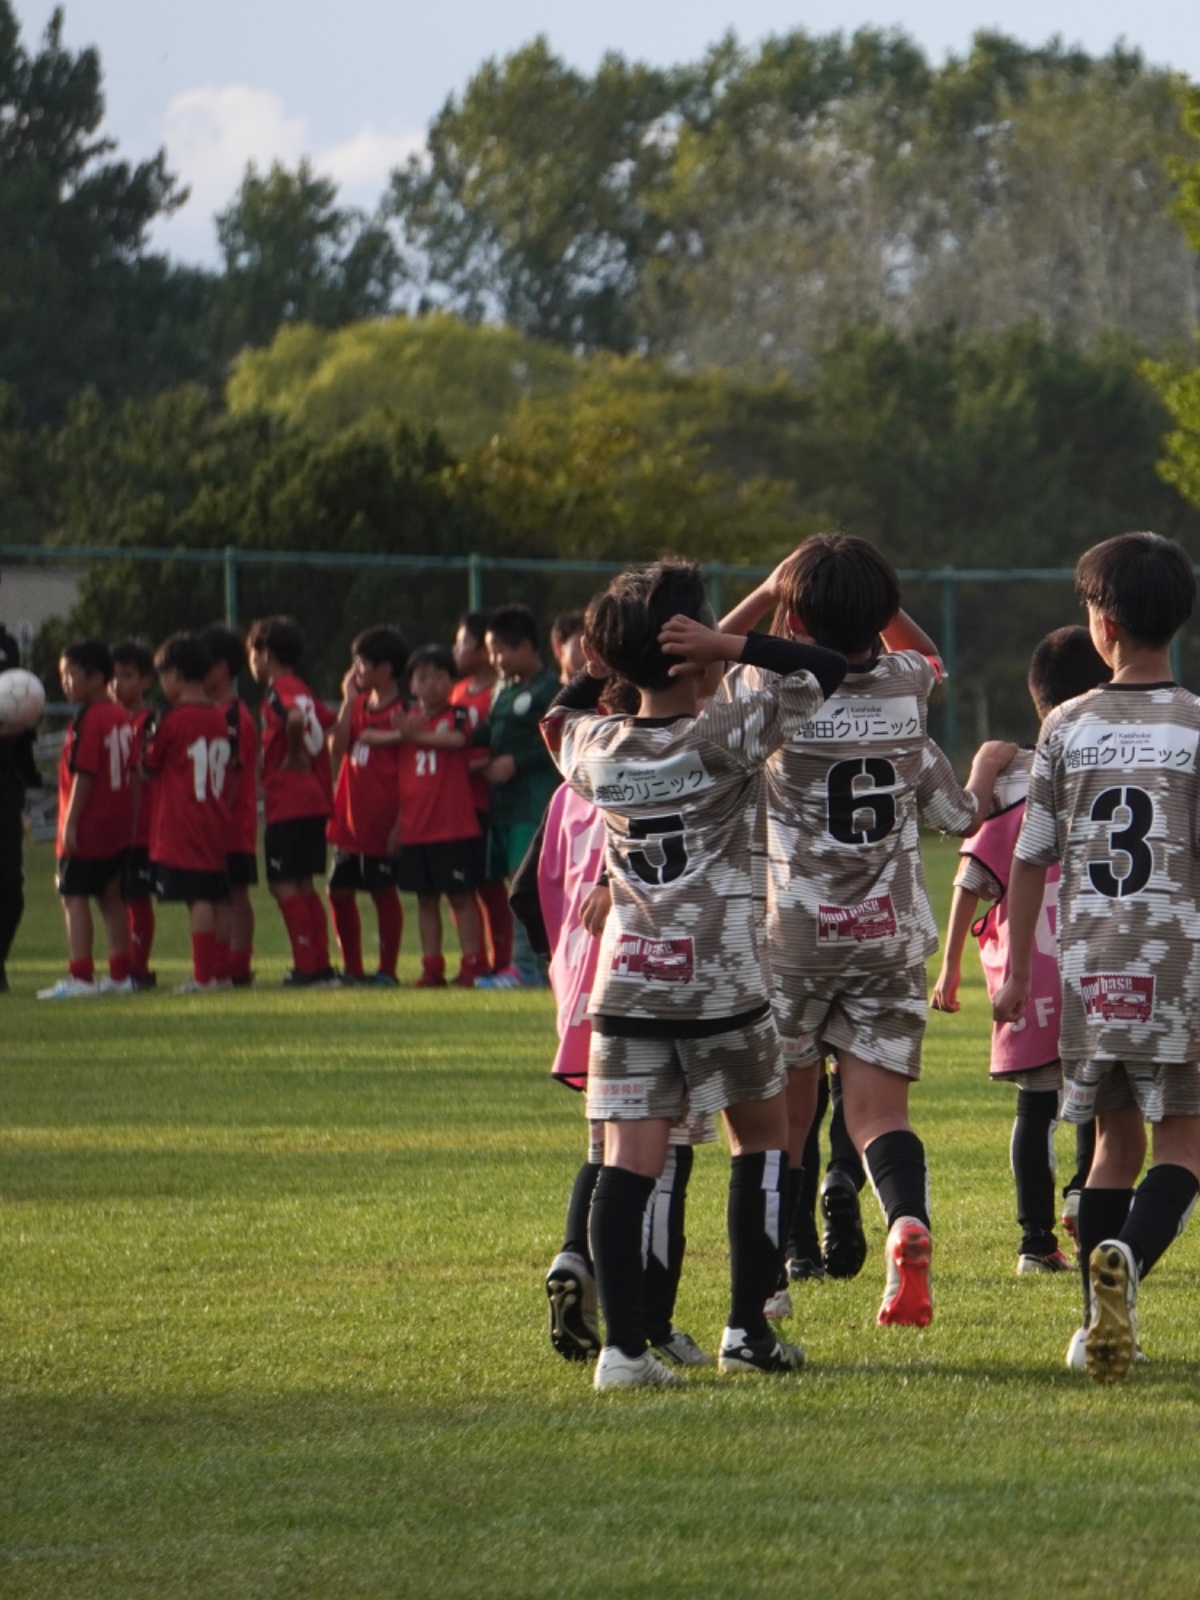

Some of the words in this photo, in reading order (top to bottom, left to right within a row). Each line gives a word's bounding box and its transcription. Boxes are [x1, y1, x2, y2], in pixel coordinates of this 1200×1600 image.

[415, 749, 437, 776] 21
[1066, 746, 1192, 768] 増田クリニック
[596, 769, 703, 802] 増田クリニック
[826, 757, 896, 845] 6
[1087, 785, 1154, 900] 3
